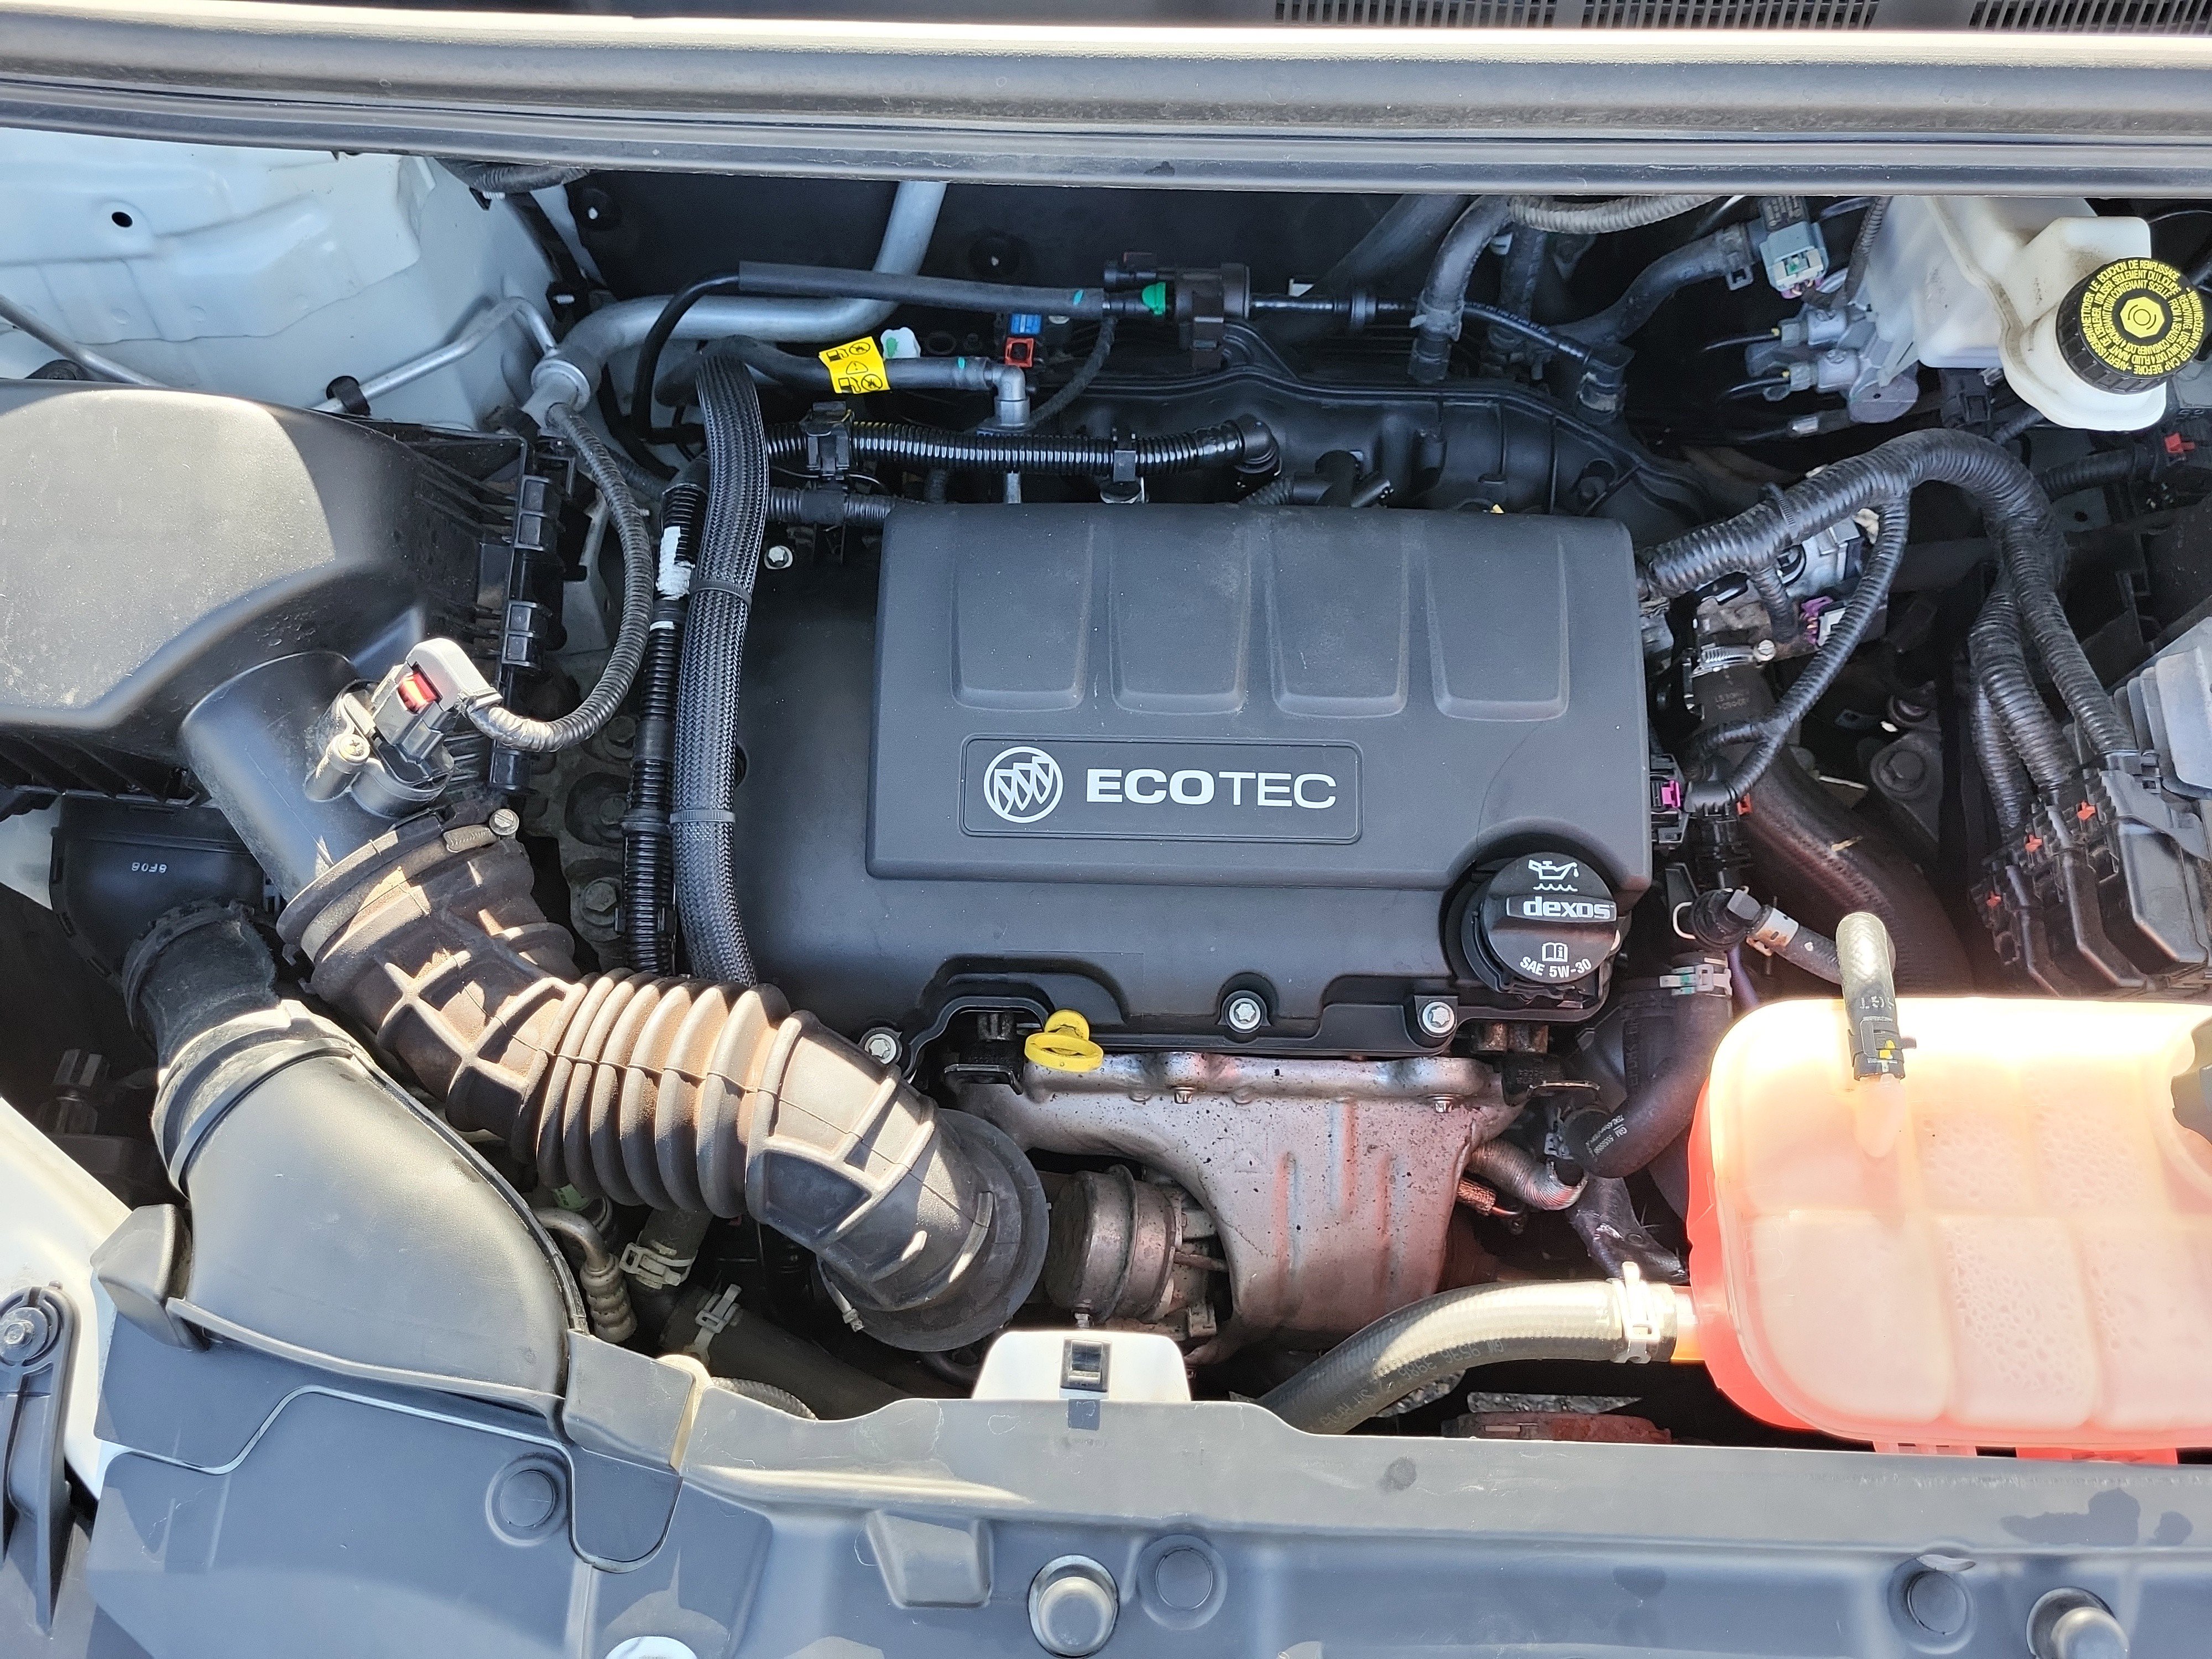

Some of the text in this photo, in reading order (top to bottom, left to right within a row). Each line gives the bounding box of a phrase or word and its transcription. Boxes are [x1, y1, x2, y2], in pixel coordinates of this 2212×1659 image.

[2112, 270, 2147, 285] SEULEMENT
[2148, 271, 2158, 281] DU
[2094, 280, 2115, 305] UTILISER
[2110, 279, 2148, 299] CONTENANT
[2157, 274, 2182, 295] LIQUIDE
[2081, 292, 2095, 326] NETTOYER
[2088, 280, 2101, 292] LE
[2096, 262, 2127, 283] BOUCHON
[2128, 260, 2138, 269] DE
[2140, 260, 2180, 281] REMPLISSAGE
[2168, 299, 2182, 316] FROM
[2102, 310, 2124, 346] PROVENANT
[2166, 322, 2182, 343] SEALED
[2191, 321, 2204, 341] CLEAN
[2099, 336, 2112, 347] DE
[2120, 340, 2127, 348] 4
[2177, 331, 2190, 347] USE
[2108, 345, 2131, 361] AVANT
[2124, 342, 2137, 354] DOT
[2166, 343, 2182, 358] ONLY
[2177, 339, 2199, 361] FILLER
[2131, 354, 2151, 365] FLUID
[2151, 356, 2155, 364] 4
[2154, 352, 2168, 363] DOT
[2164, 357, 2180, 371] CAP
[2133, 364, 2163, 375] BEFORE
[1086, 769, 1337, 809] ECOTEC
[1524, 896, 1610, 919] dexos
[1520, 956, 1592, 978] SAE 5W-30
